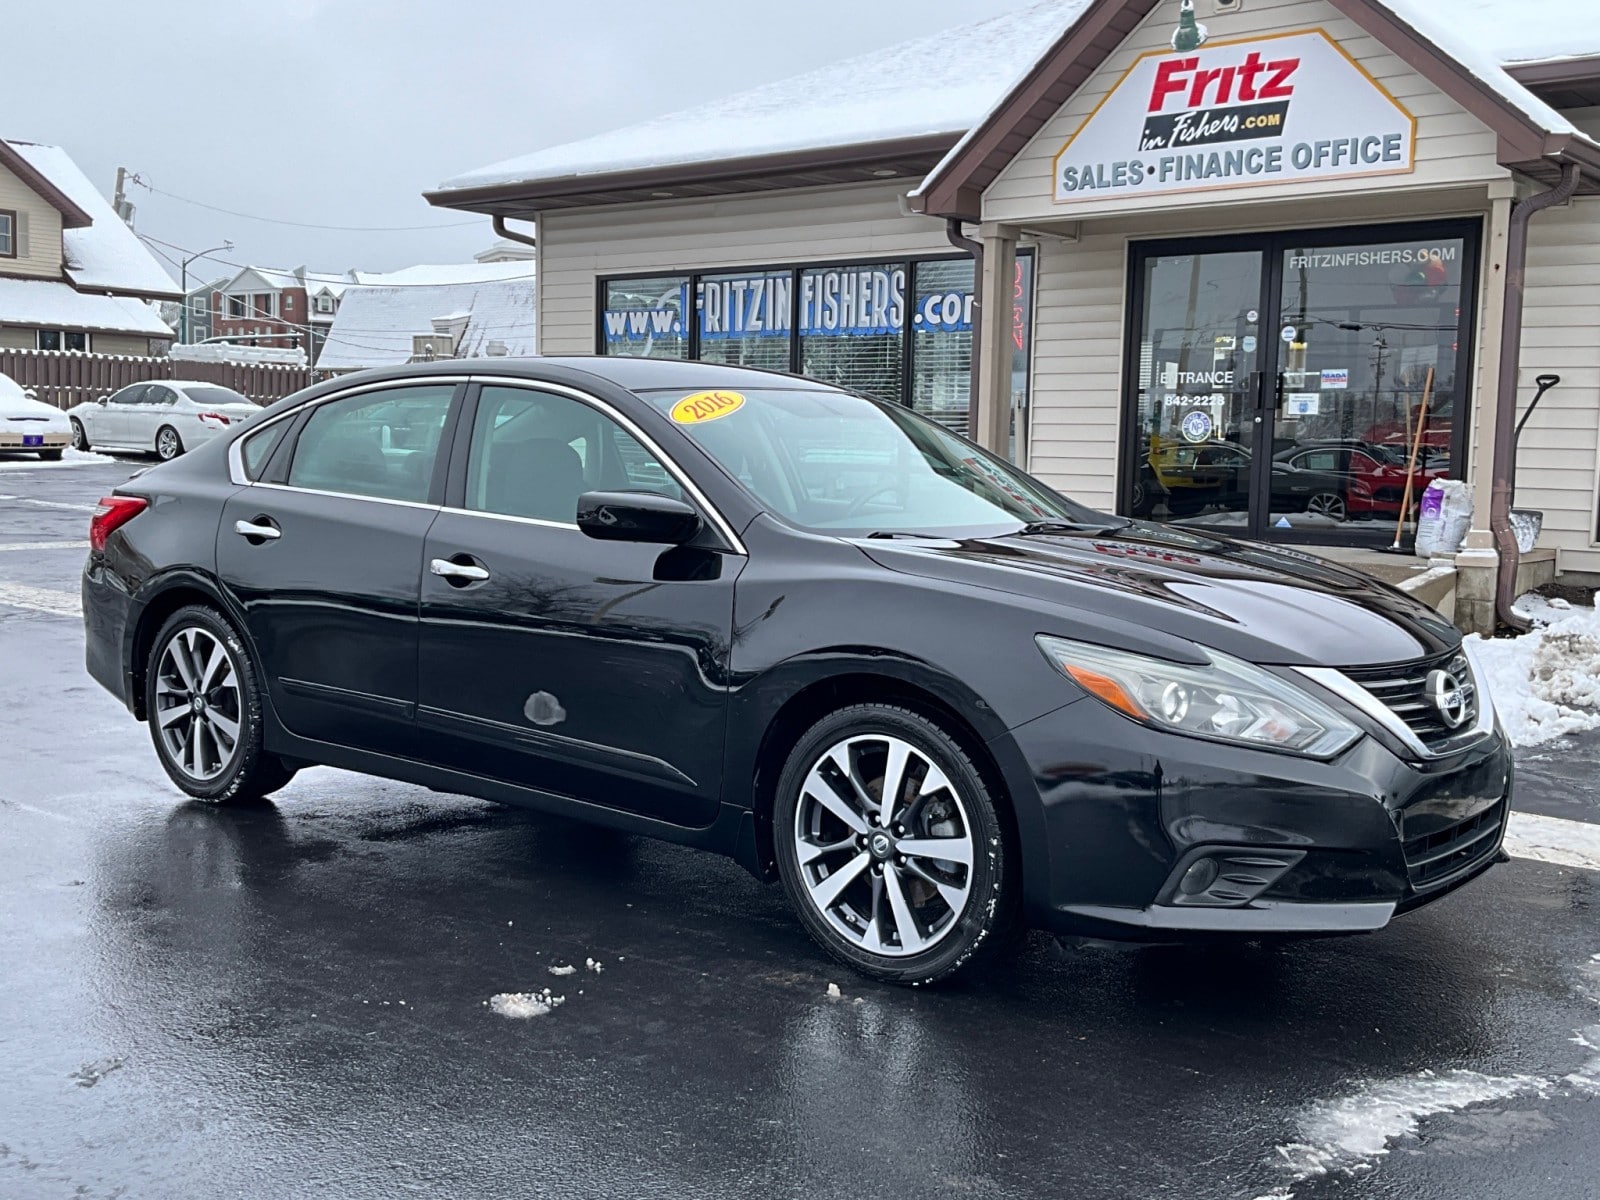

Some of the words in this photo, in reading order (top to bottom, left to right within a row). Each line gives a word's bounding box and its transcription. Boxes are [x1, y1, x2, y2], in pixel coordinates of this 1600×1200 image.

[1148, 52, 1300, 112] Fritz
[1141, 129, 1165, 150] in
[1063, 159, 1144, 192] SALES
[1158, 145, 1283, 183] FINANCE
[1291, 133, 1403, 170] OFFICE
[1289, 247, 1456, 269] FRITZINFISHERS.COM
[1160, 371, 1234, 384] ETRANCE
[683, 392, 735, 420] 2016
